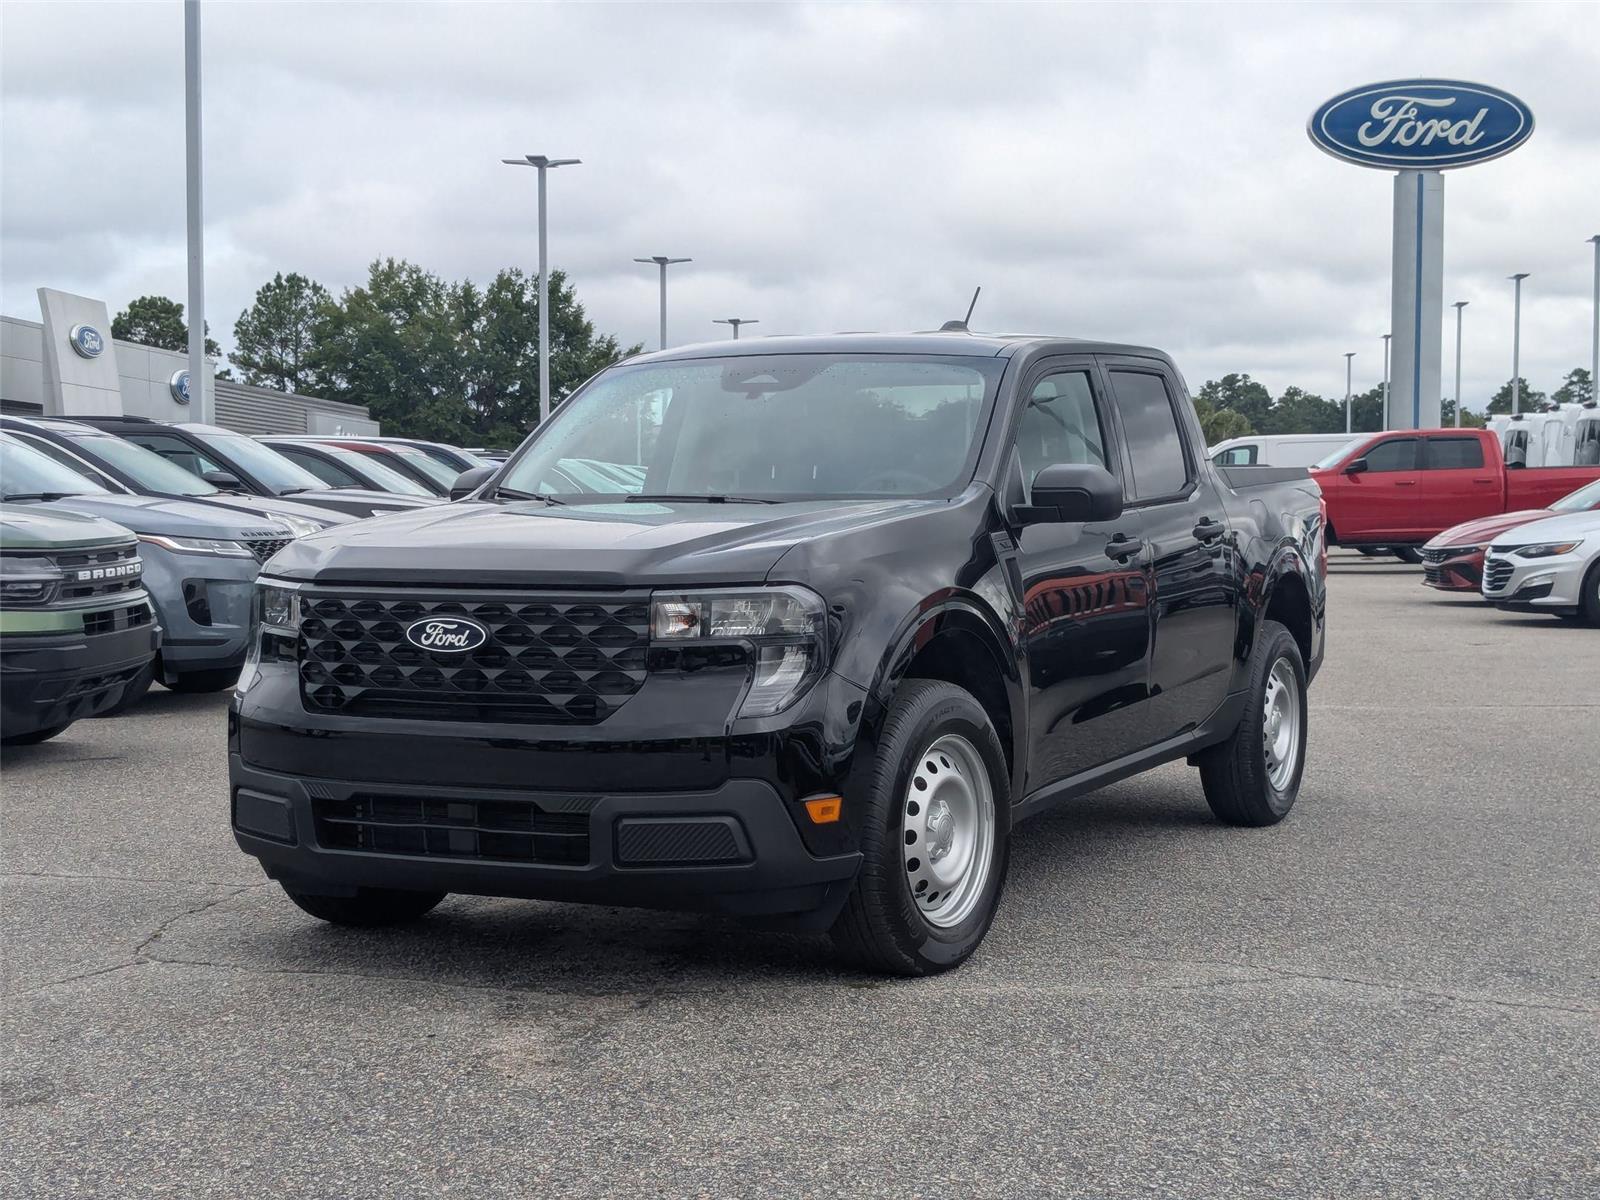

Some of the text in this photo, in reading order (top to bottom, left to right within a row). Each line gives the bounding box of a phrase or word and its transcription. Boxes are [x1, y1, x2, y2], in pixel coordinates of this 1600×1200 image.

[1357, 96, 1489, 147] Ford
[84, 331, 101, 350] Ford
[78, 563, 141, 581] BRONCO
[421, 622, 470, 647] Ford
